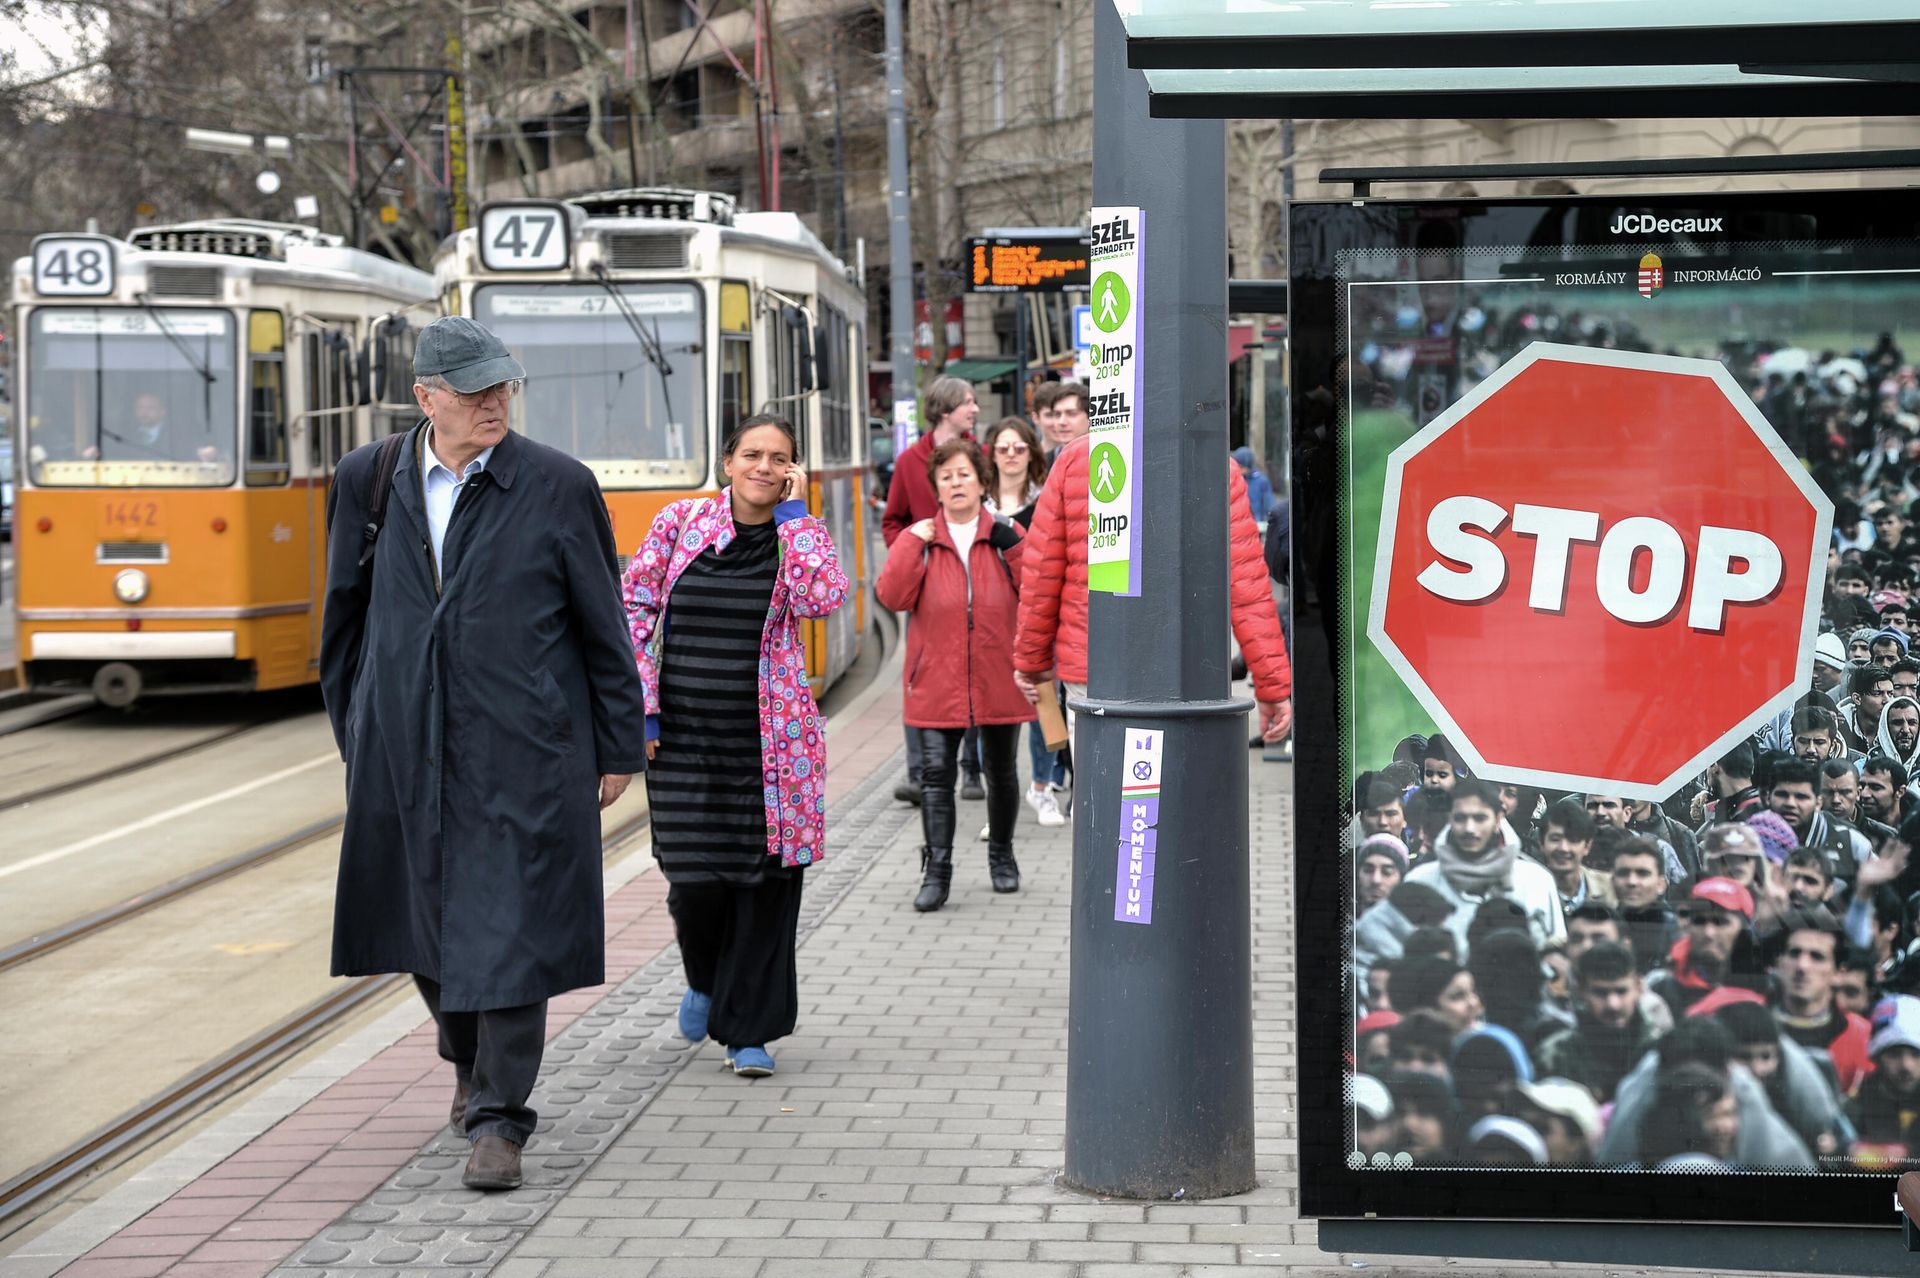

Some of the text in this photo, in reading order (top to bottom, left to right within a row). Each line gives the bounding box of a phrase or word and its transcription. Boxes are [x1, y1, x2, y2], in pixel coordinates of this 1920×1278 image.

[493, 215, 555, 257] 47
[1092, 215, 1135, 246] SZÉL
[1610, 214, 1723, 234] JCDecaux
[43, 249, 103, 286] 48
[1555, 266, 1762, 286] KORMÁNY INFORMÁCIÓ
[1096, 363, 1120, 380] 2018
[1089, 387, 1131, 417] SZÉL
[105, 503, 157, 527] 1442
[1092, 533, 1117, 549] 2018
[1416, 495, 1783, 631] STOP
[1126, 804, 1147, 917] MOMENTUM
